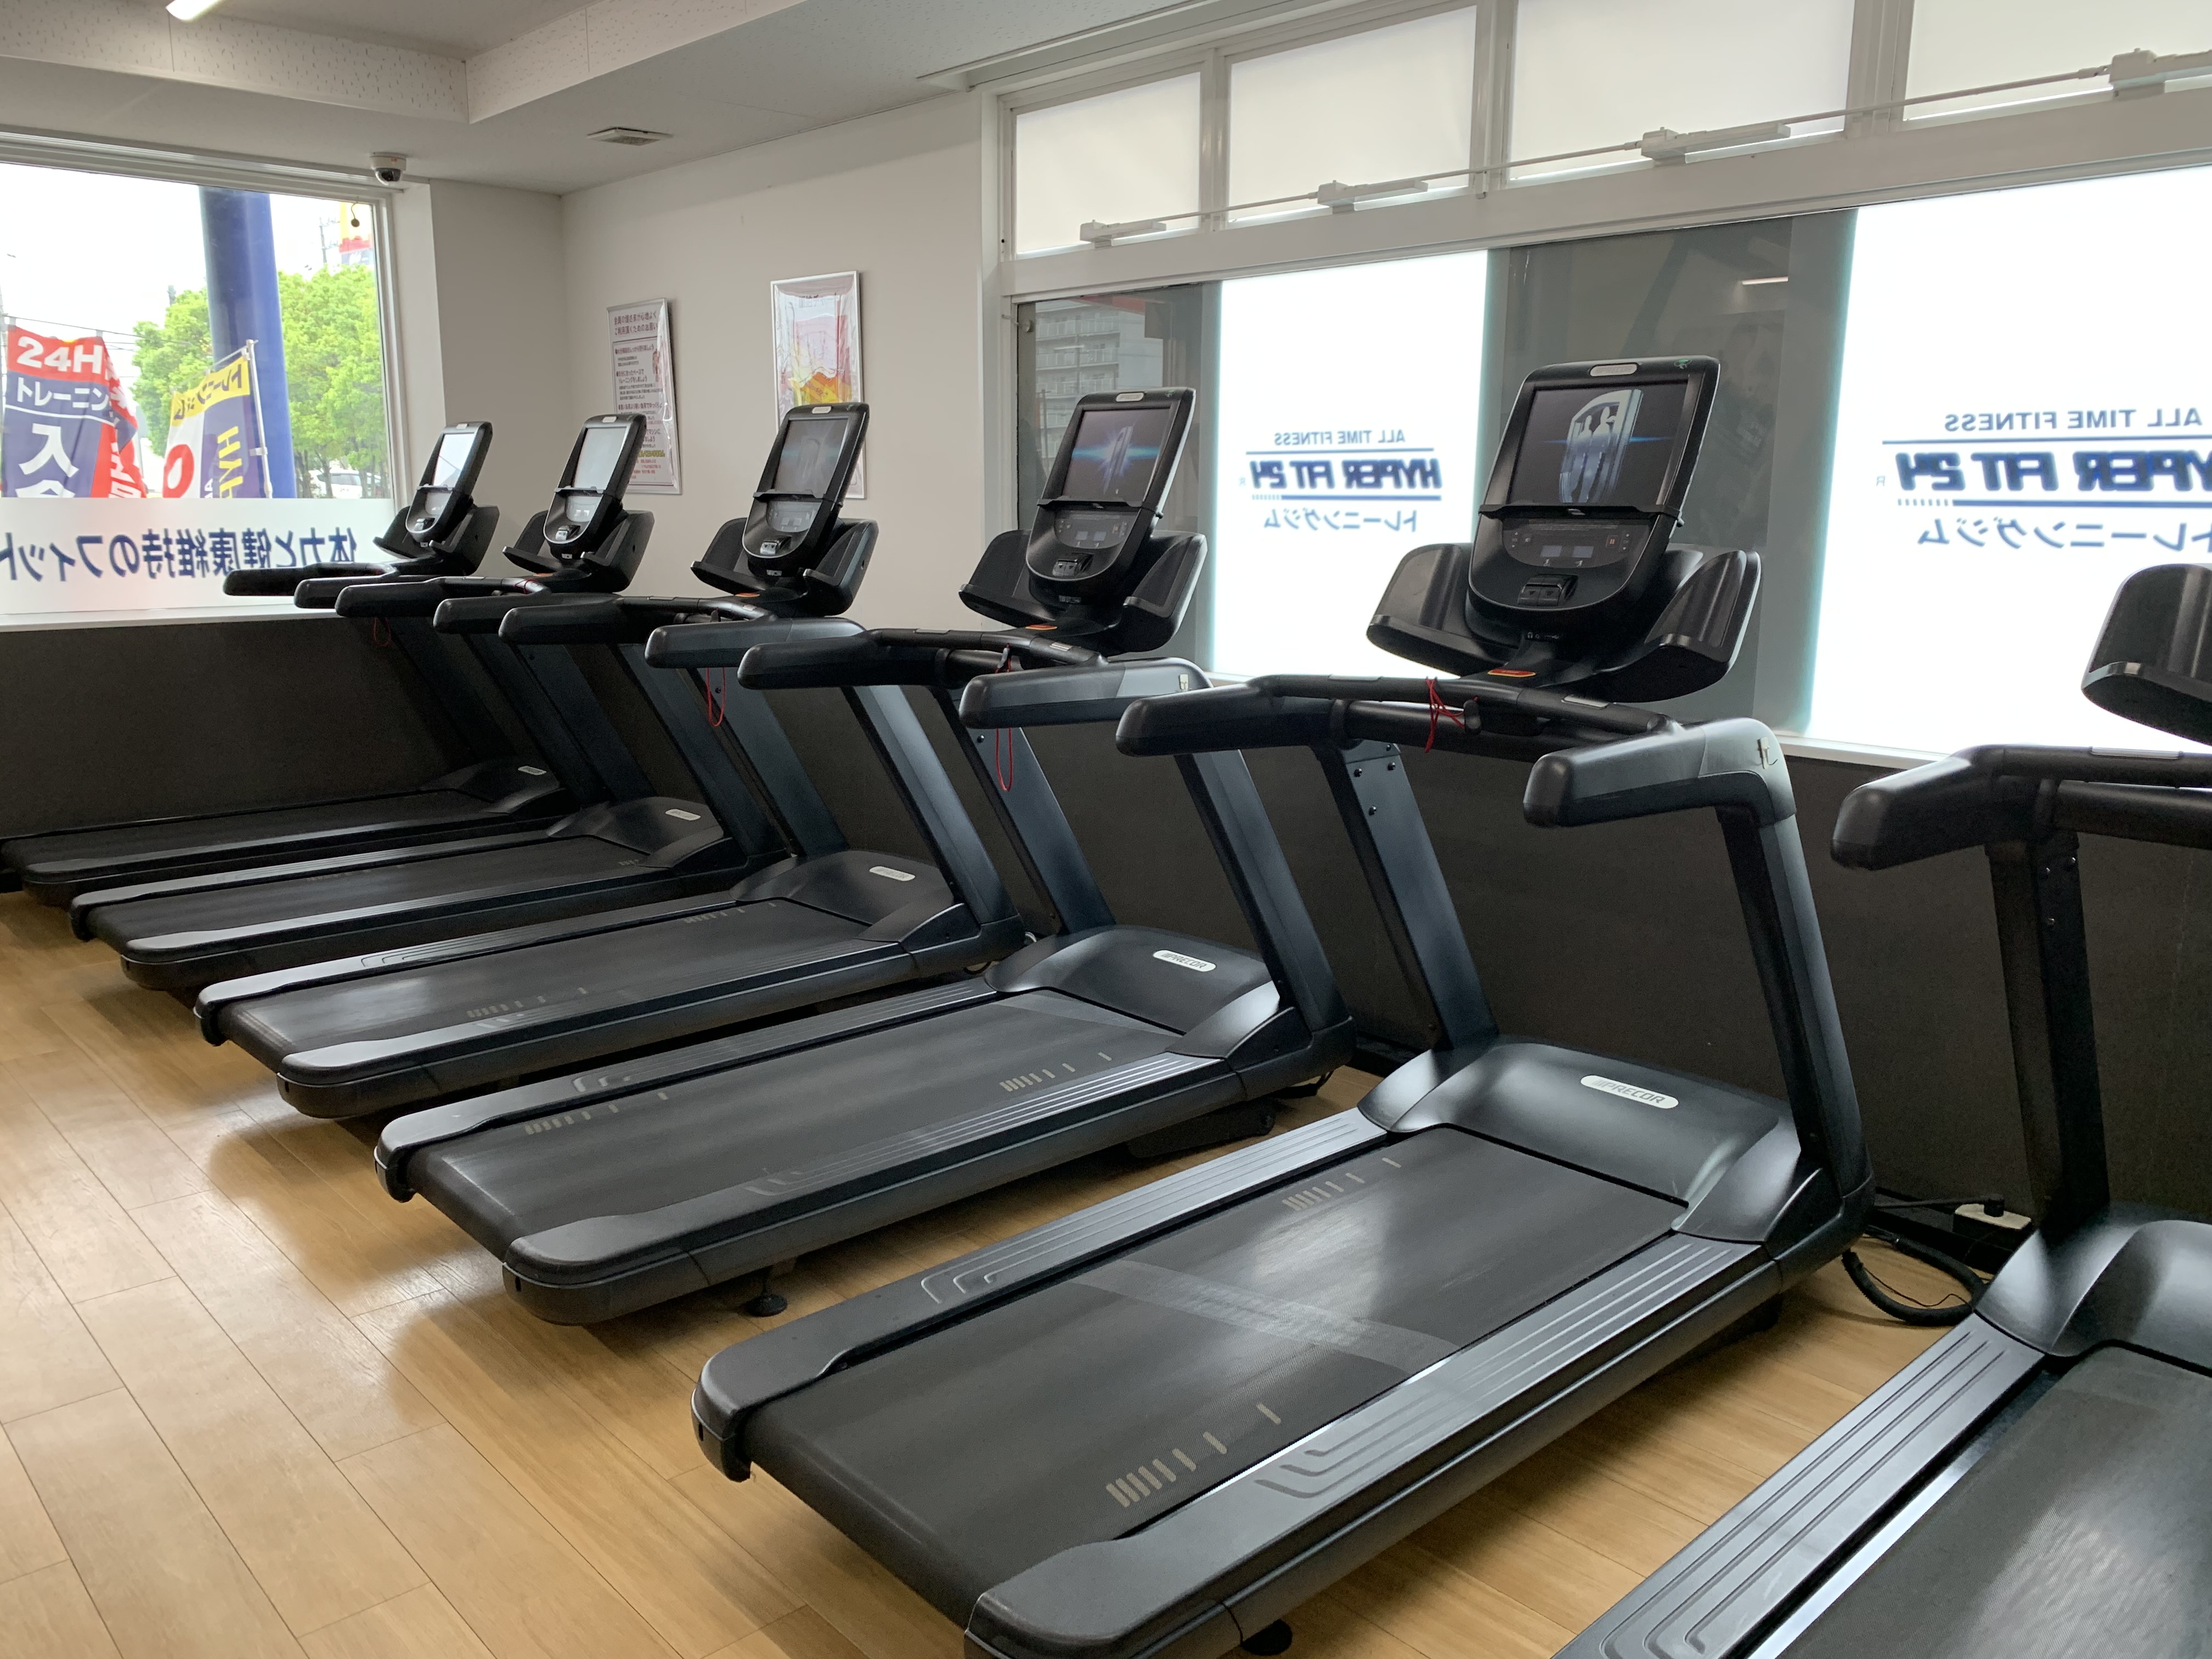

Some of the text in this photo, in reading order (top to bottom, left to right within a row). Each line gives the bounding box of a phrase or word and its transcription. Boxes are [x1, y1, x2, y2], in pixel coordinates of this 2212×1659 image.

[16, 336, 103, 374] 24H
[1169, 954, 1207, 968] PRECOR
[1600, 1082, 1666, 1104] PRECOR
